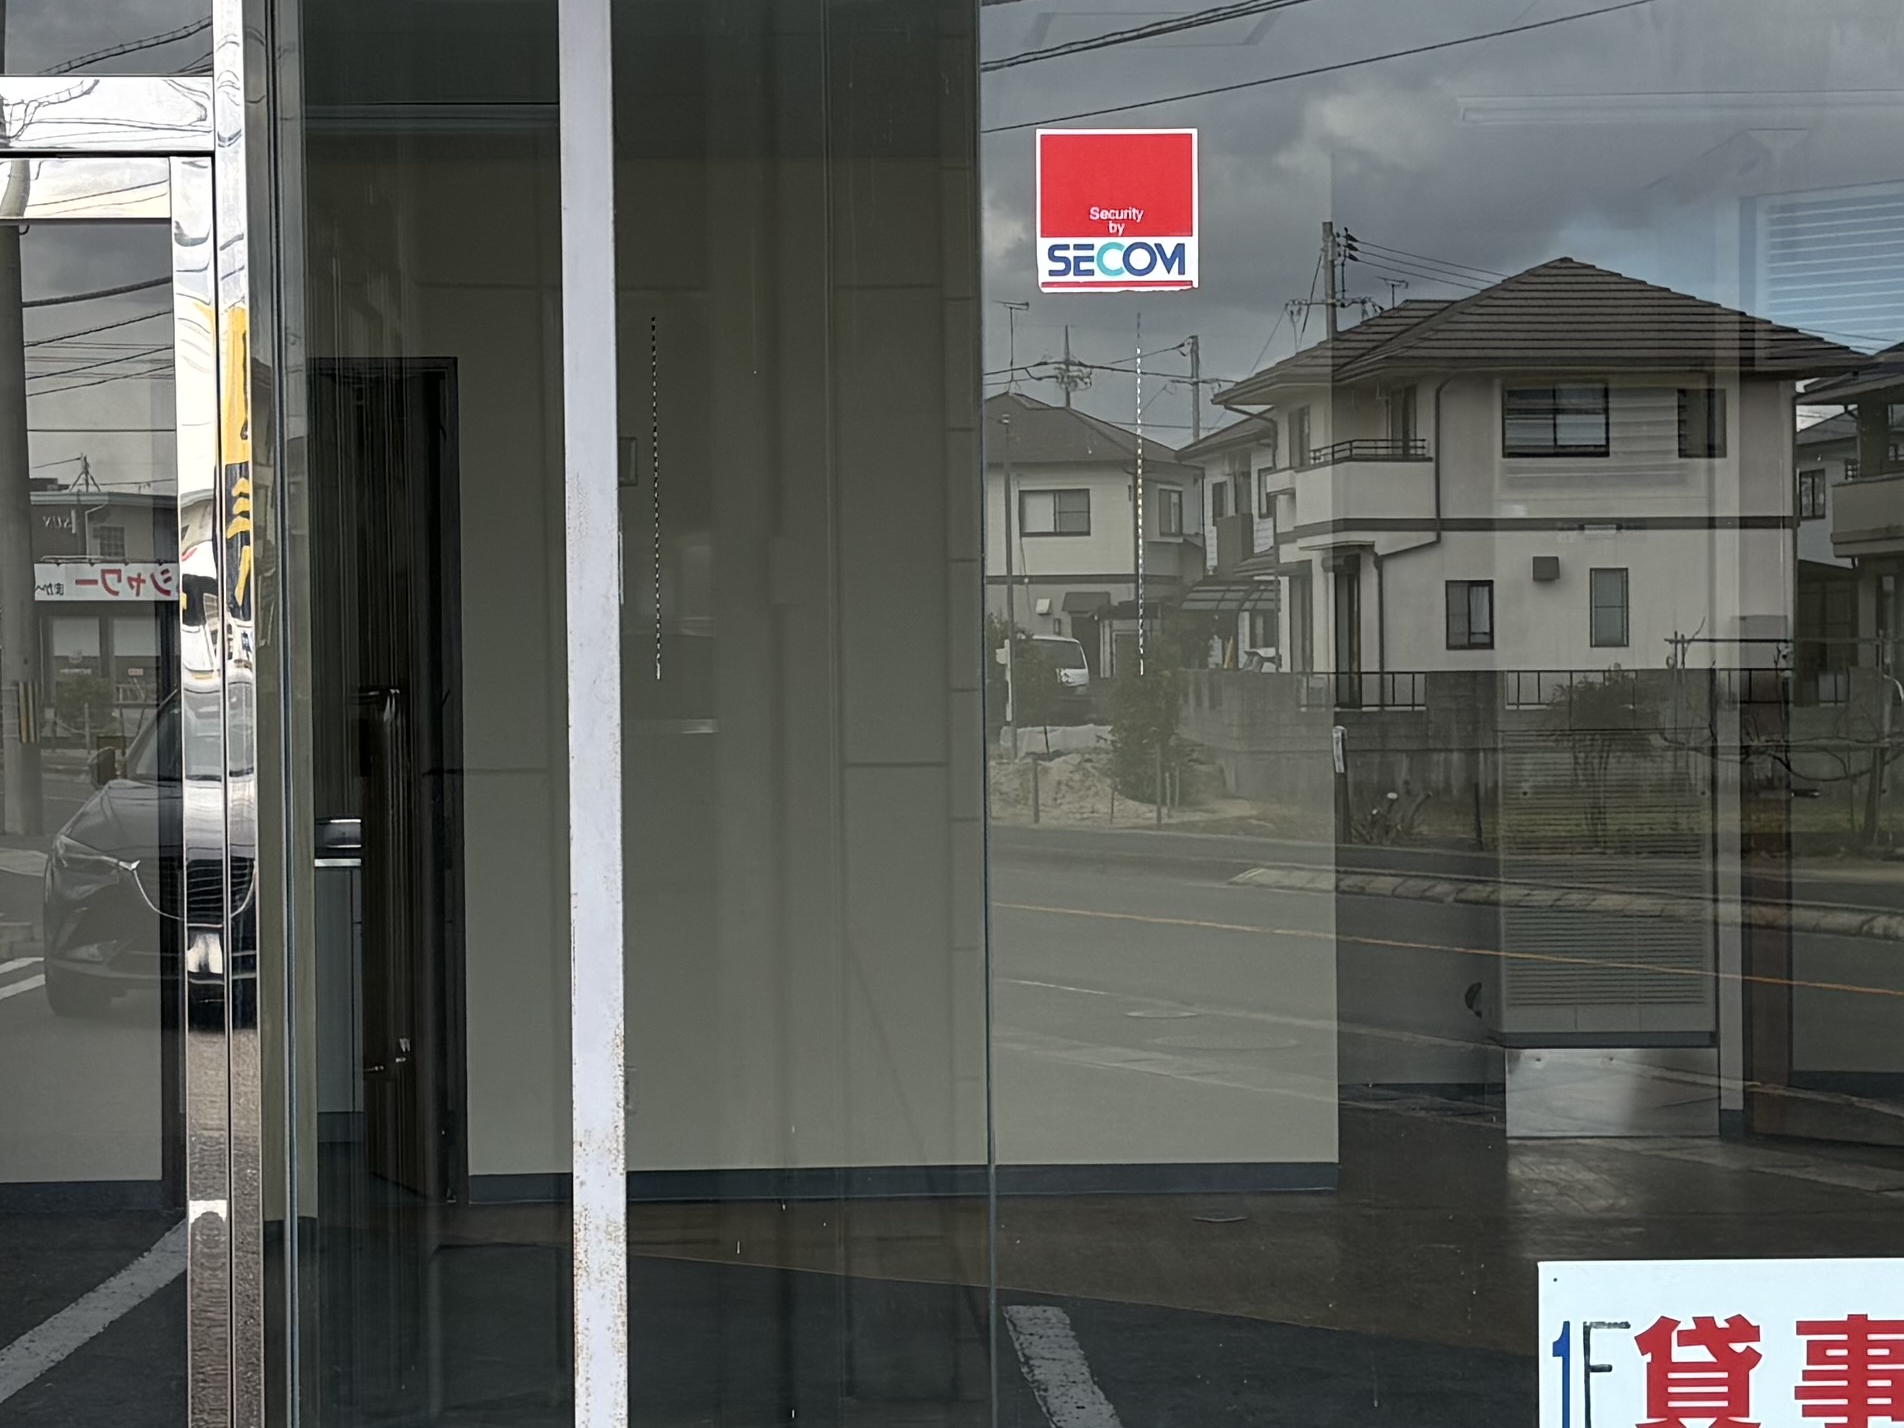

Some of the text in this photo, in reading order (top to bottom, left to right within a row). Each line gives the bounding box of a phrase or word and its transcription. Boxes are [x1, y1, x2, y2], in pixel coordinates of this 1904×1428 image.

[1089, 206, 1144, 223] Security
[1108, 221, 1125, 236] by
[1047, 241, 1186, 277] SECOM
